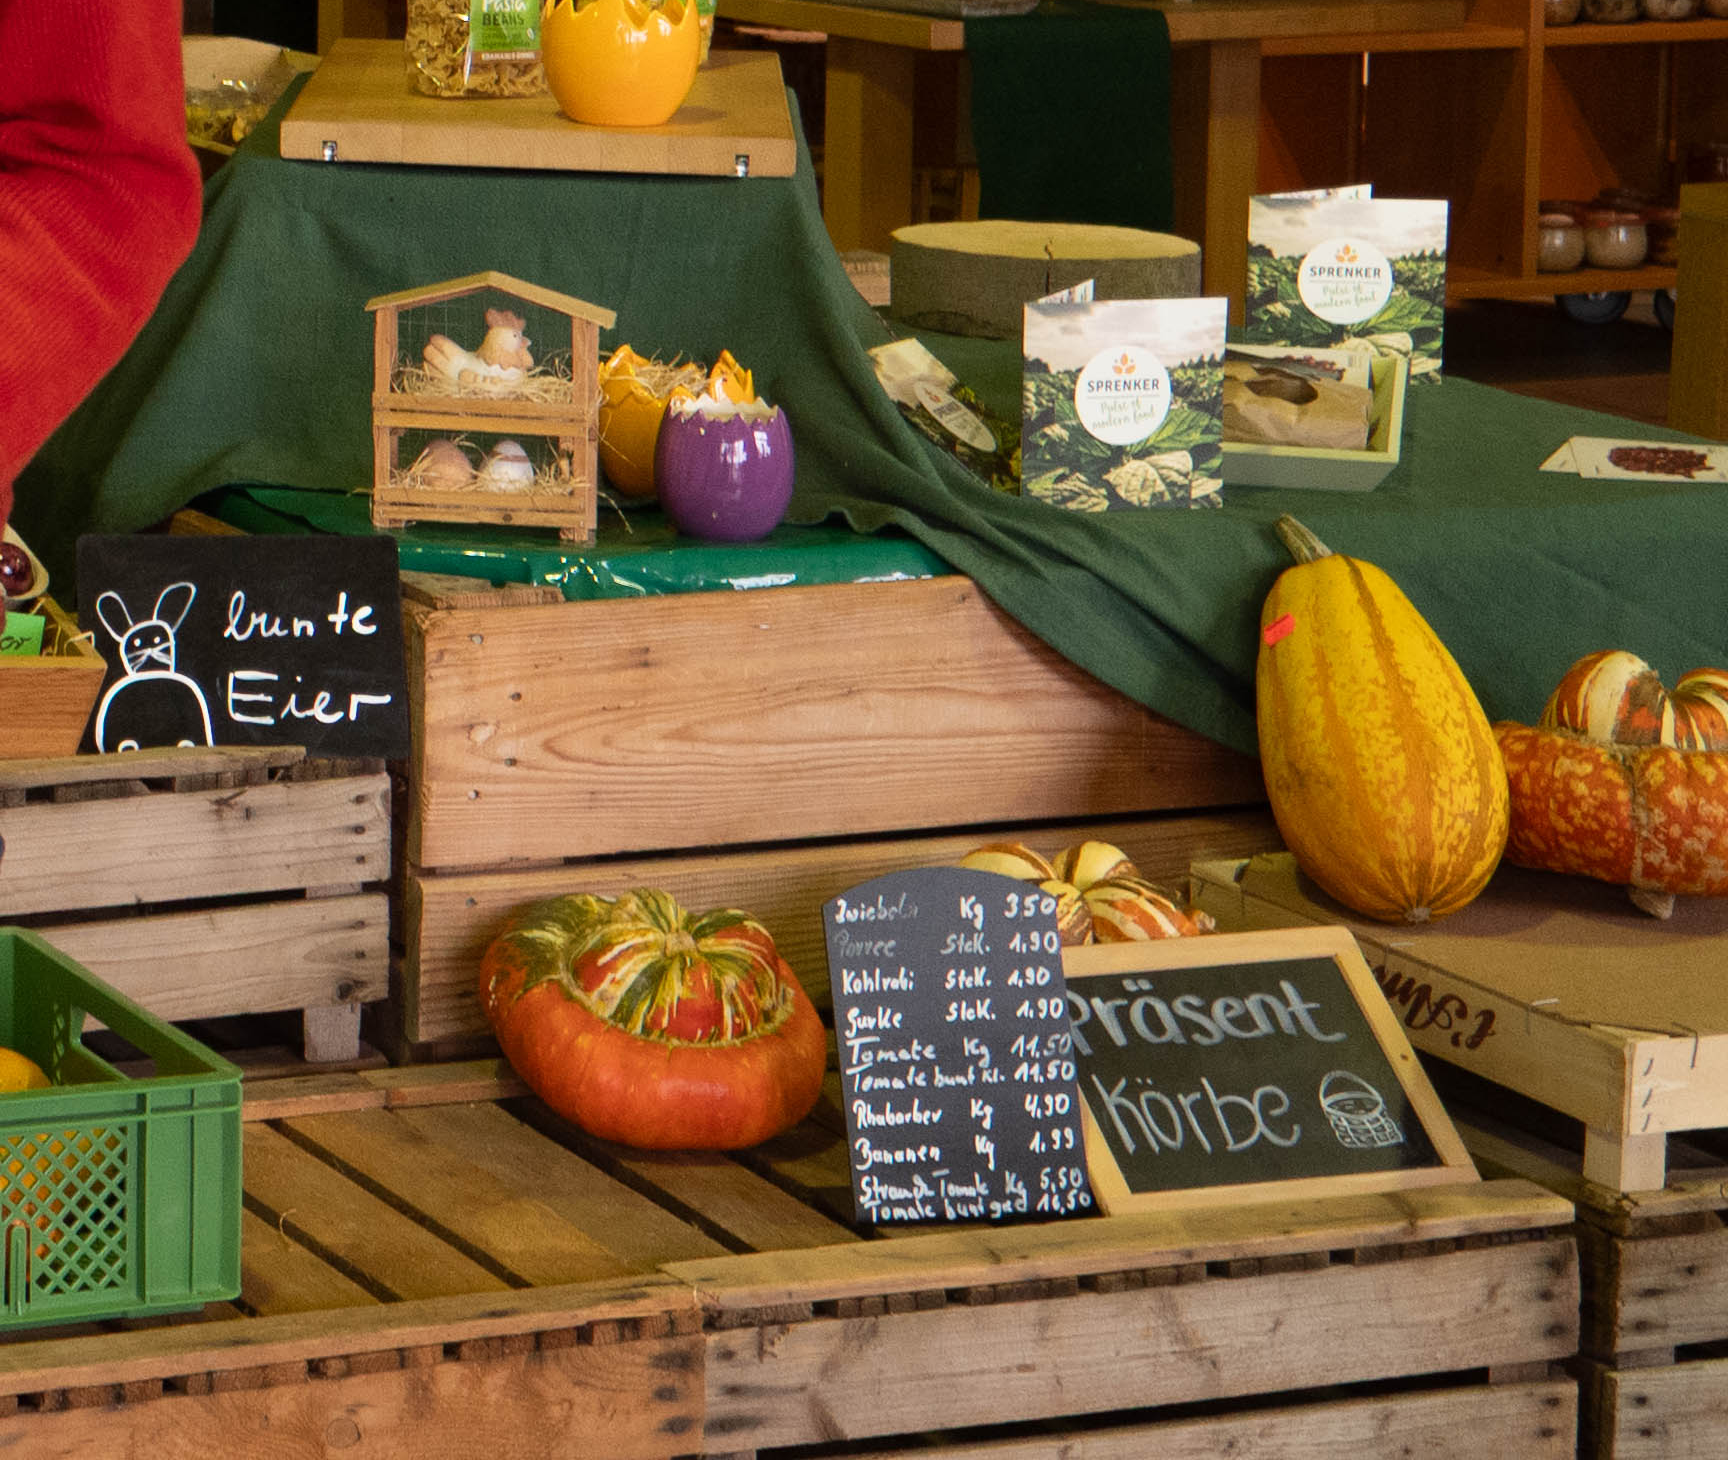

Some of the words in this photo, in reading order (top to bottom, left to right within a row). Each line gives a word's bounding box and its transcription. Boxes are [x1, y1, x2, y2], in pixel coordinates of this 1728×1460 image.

[482, 12, 526, 27] BEANS
[1308, 266, 1382, 279] SPRENKER
[1086, 378, 1160, 393] SPRENKER
[223, 589, 378, 641] bunte
[228, 670, 392, 725] Eier
[1008, 931, 1059, 955] 1,90
[842, 966, 916, 995] Kohlrabi
[1007, 966, 1051, 988] 1,90
[1016, 997, 1064, 1020] 1,90
[1066, 978, 1347, 1057] Präsent
[845, 1035, 937, 1065] Tomate
[845, 1062, 927, 1092] Tomate
[1013, 1061, 1077, 1084] 11,50
[852, 1097, 944, 1130] Rhabarber
[1024, 1092, 1072, 1119] 4,90
[1090, 1074, 1301, 1155] Körbe
[854, 1136, 942, 1171] Bananen
[1028, 1126, 1076, 1155] 1,99
[1040, 1166, 1084, 1194] 5,50
[864, 1198, 937, 1224] Tomate
